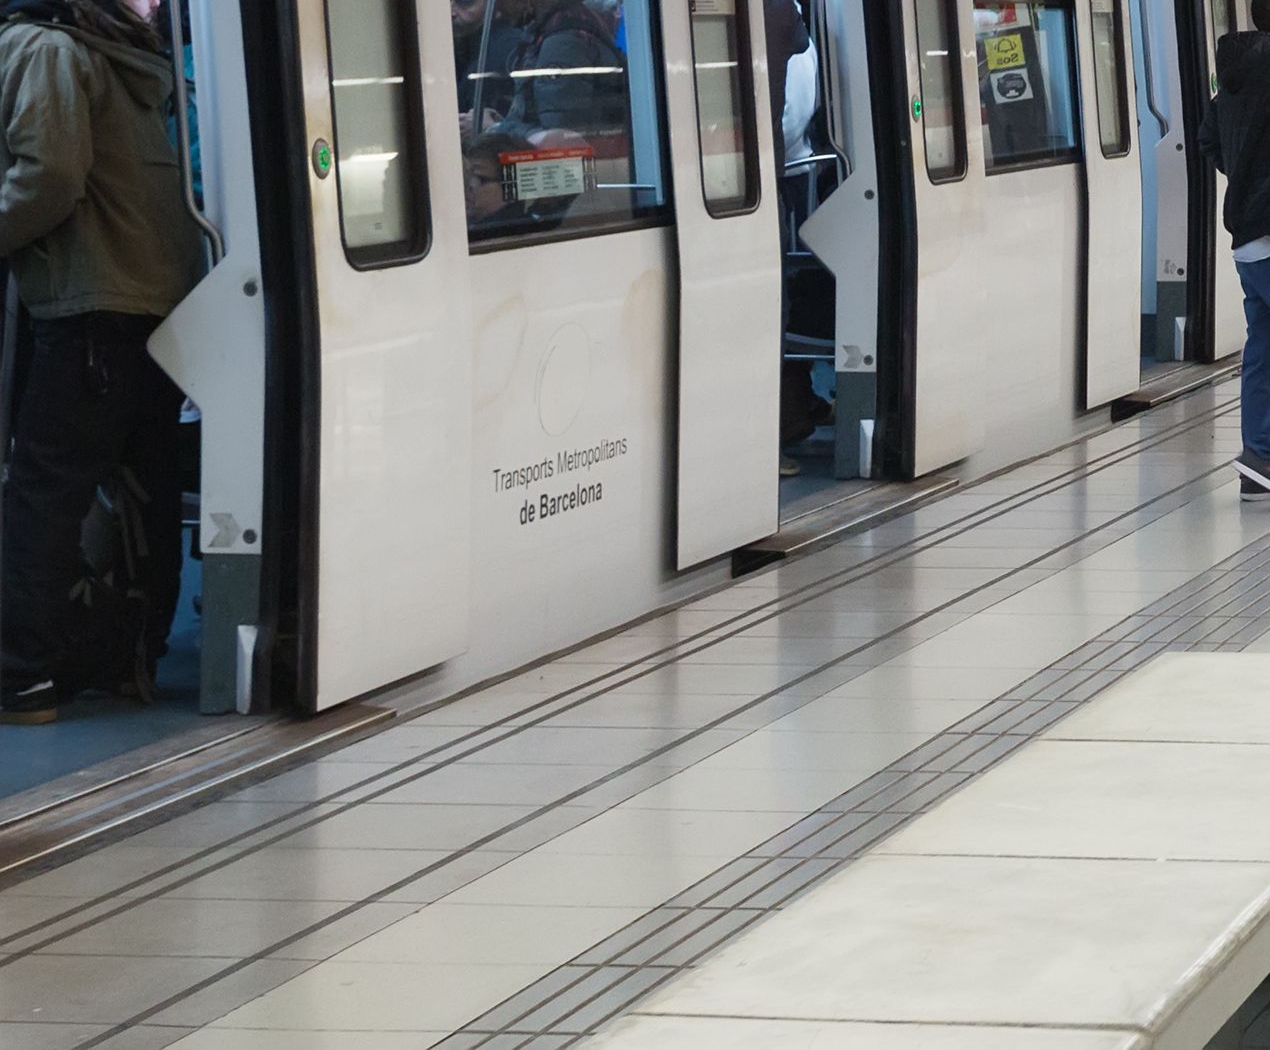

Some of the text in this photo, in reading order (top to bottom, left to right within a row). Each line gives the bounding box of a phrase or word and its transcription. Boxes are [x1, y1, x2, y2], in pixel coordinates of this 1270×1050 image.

[493, 437, 628, 493] Transports Metropolitans
[519, 481, 603, 526] de Barcelona
